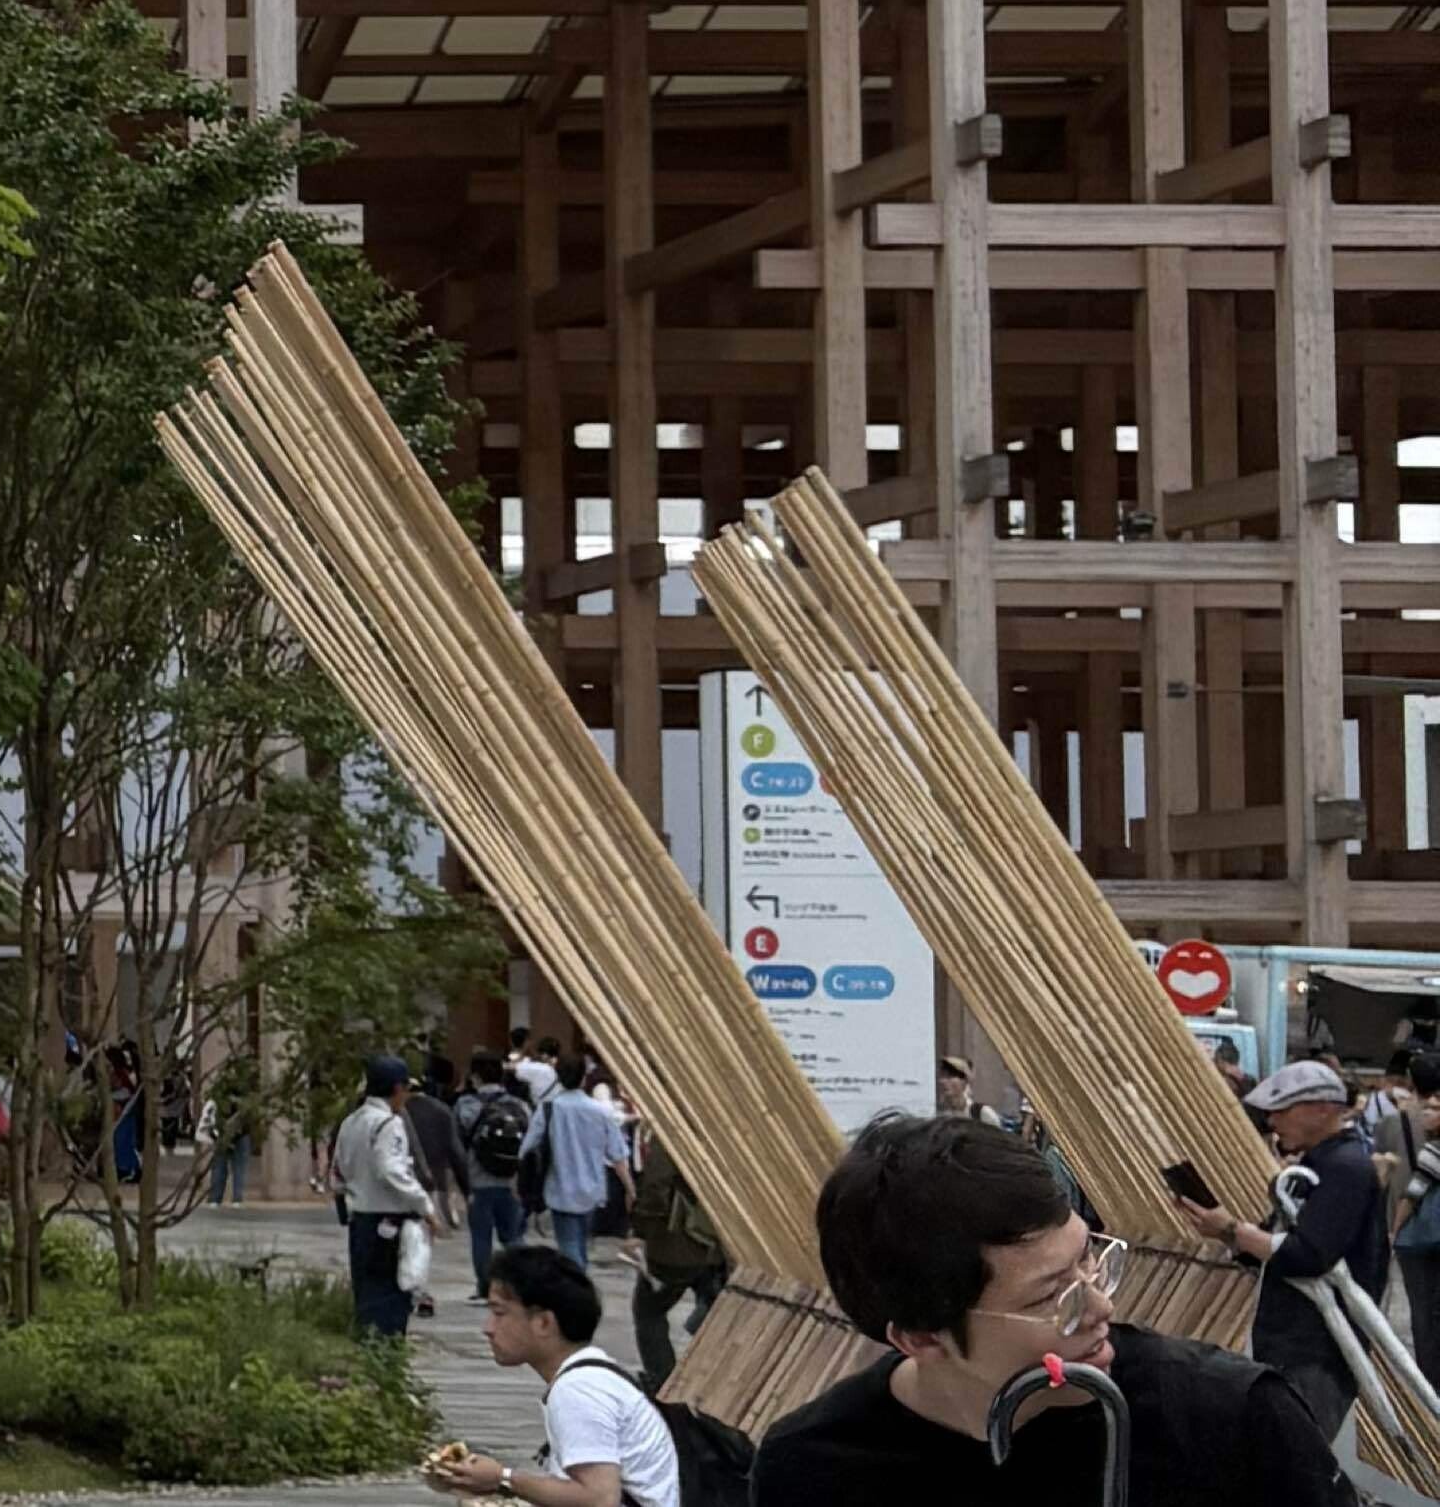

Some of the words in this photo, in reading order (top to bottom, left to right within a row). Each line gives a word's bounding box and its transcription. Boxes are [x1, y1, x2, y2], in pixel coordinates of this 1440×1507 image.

[752, 732, 764, 747] F
[750, 770, 765, 789] C
[754, 934, 768, 953] E
[751, 973, 769, 991] W
[831, 973, 846, 992] C
